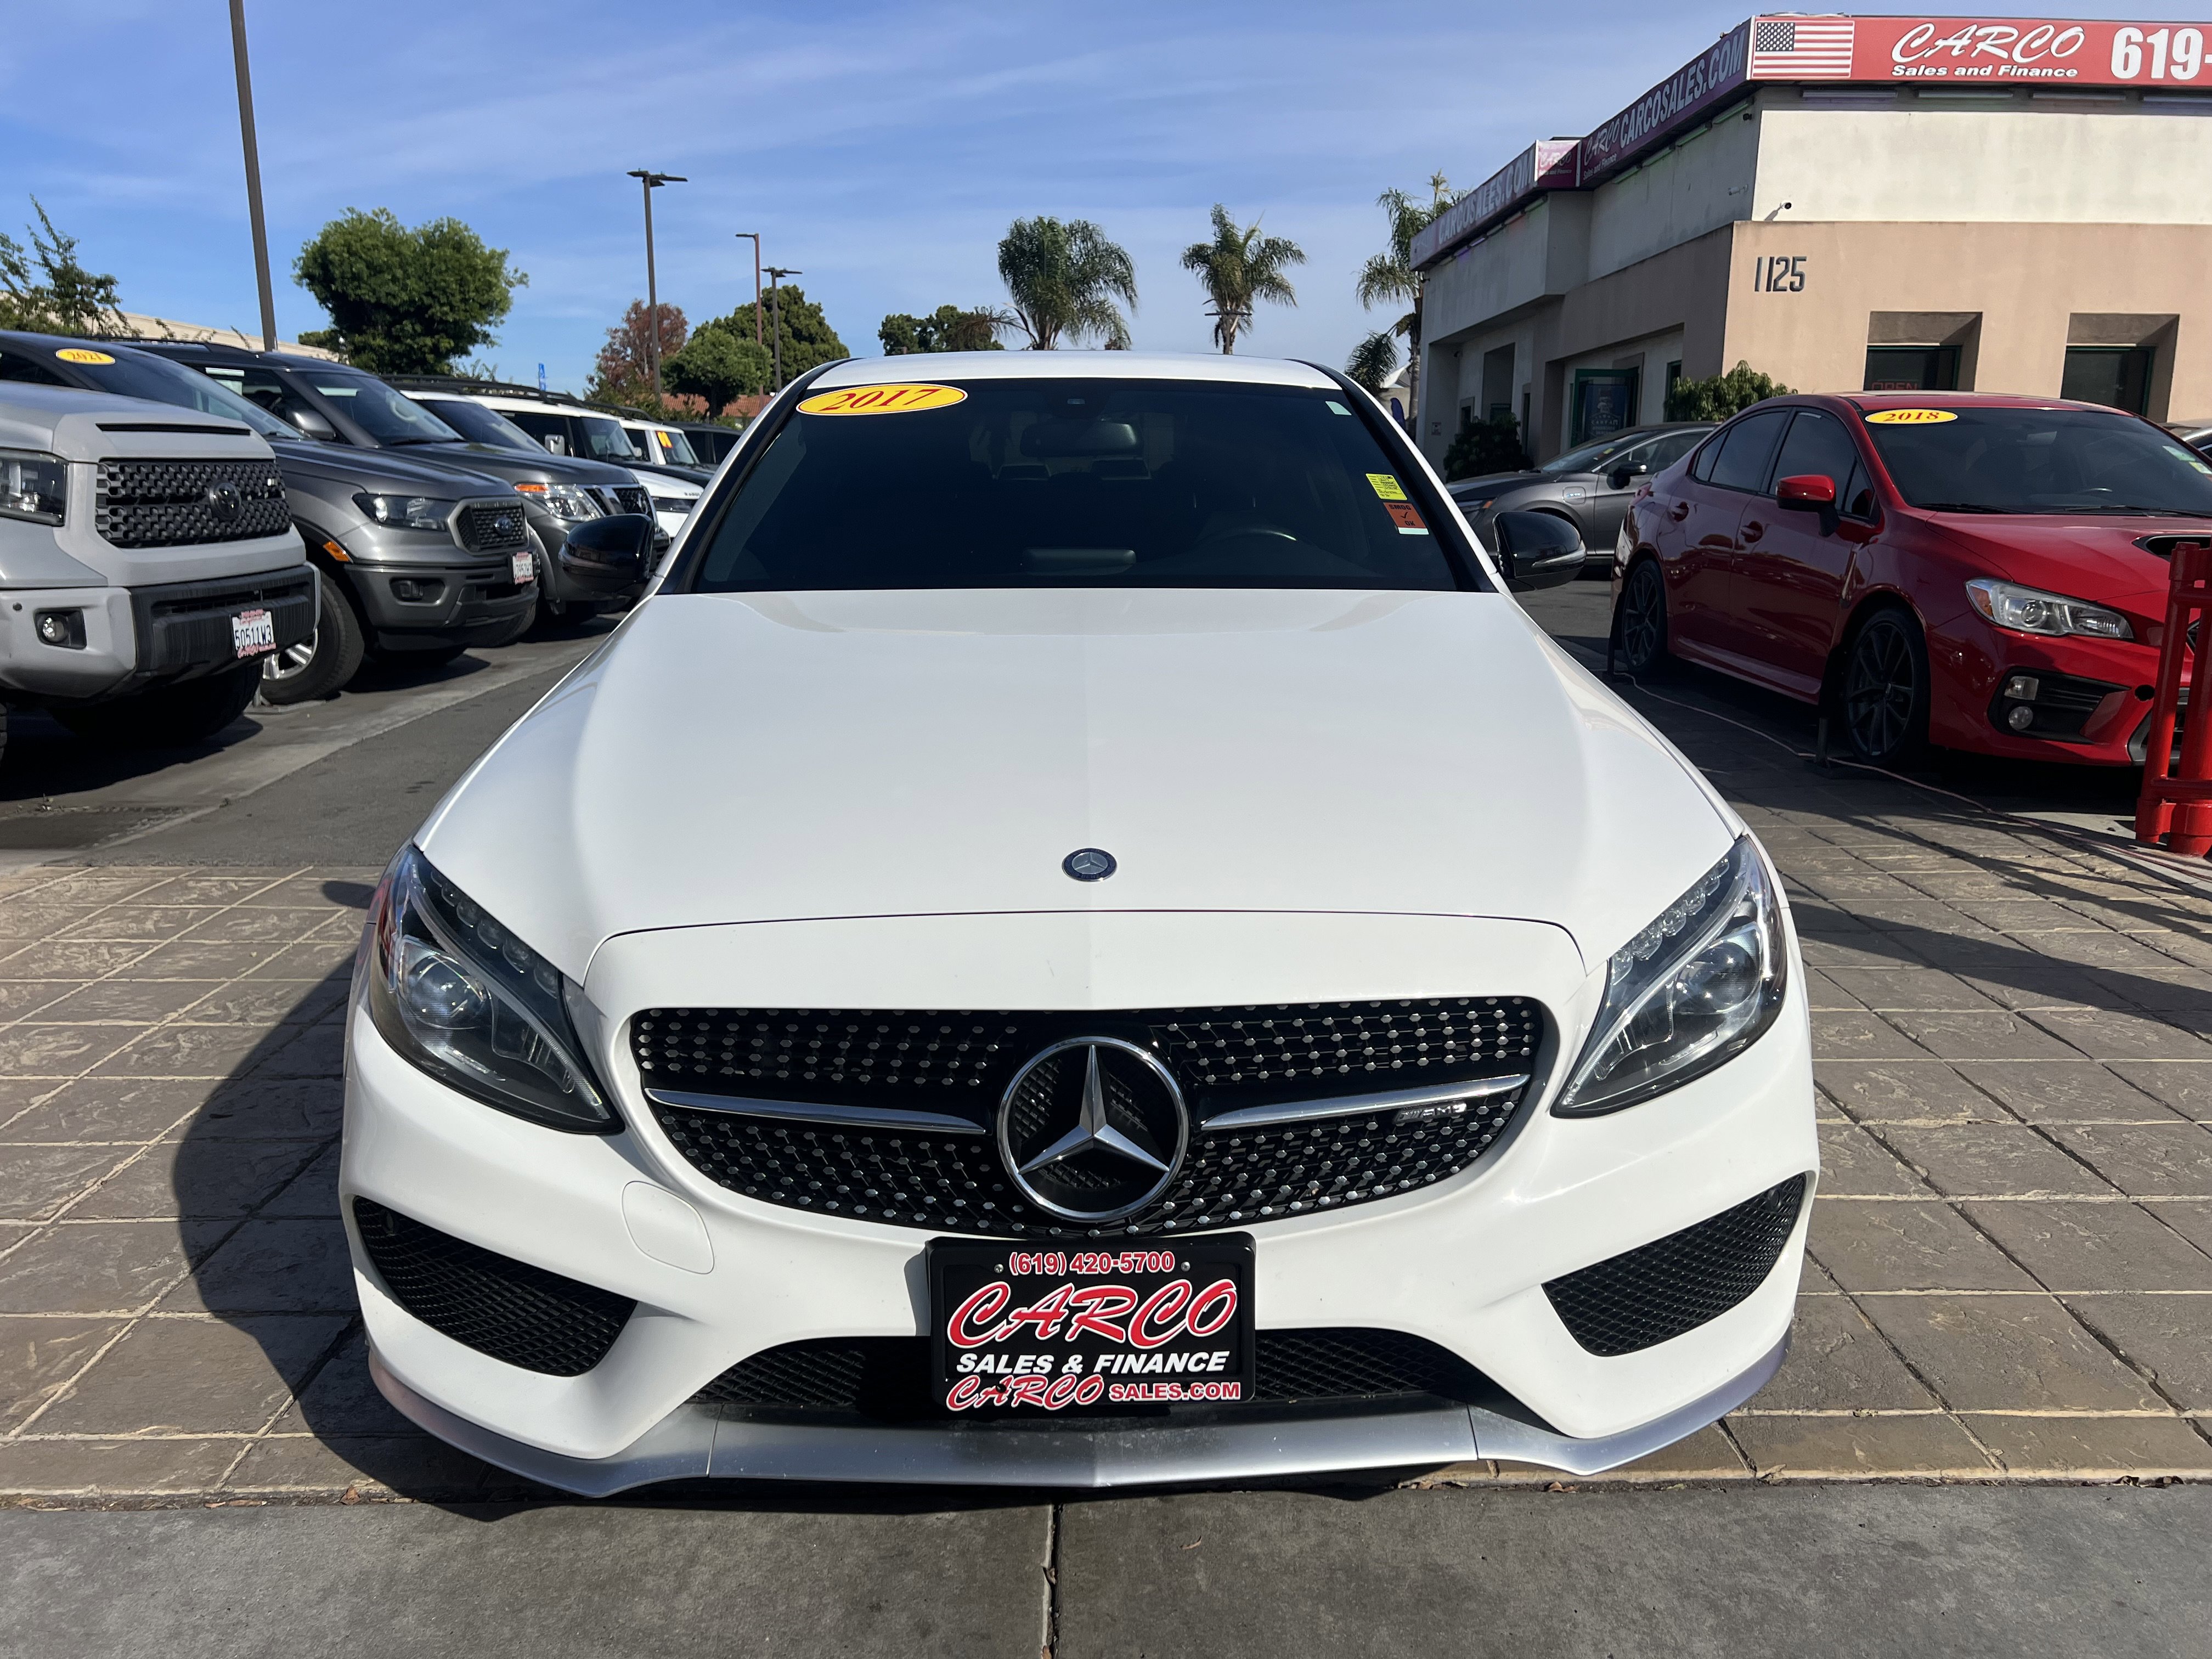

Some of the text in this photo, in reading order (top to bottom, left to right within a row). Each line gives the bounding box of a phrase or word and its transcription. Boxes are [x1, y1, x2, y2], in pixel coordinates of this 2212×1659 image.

[1892, 22, 2085, 63] CARCO
[1892, 64, 2078, 77] Sales and Finance
[1584, 29, 1746, 166] CARCO CARCOSALES.COM
[1438, 147, 1534, 245] CARCOSALES.COM
[1754, 256, 1807, 292] 1125
[817, 388, 943, 411] 2017
[1883, 411, 1939, 422] 2018
[1009, 1251, 1175, 1276] (619) 420-5700
[947, 1279, 1238, 1350] CARCO
[956, 1351, 1229, 1374] SALES & FINANCE
[945, 1374, 1241, 1412] CARCO SALES.COM
